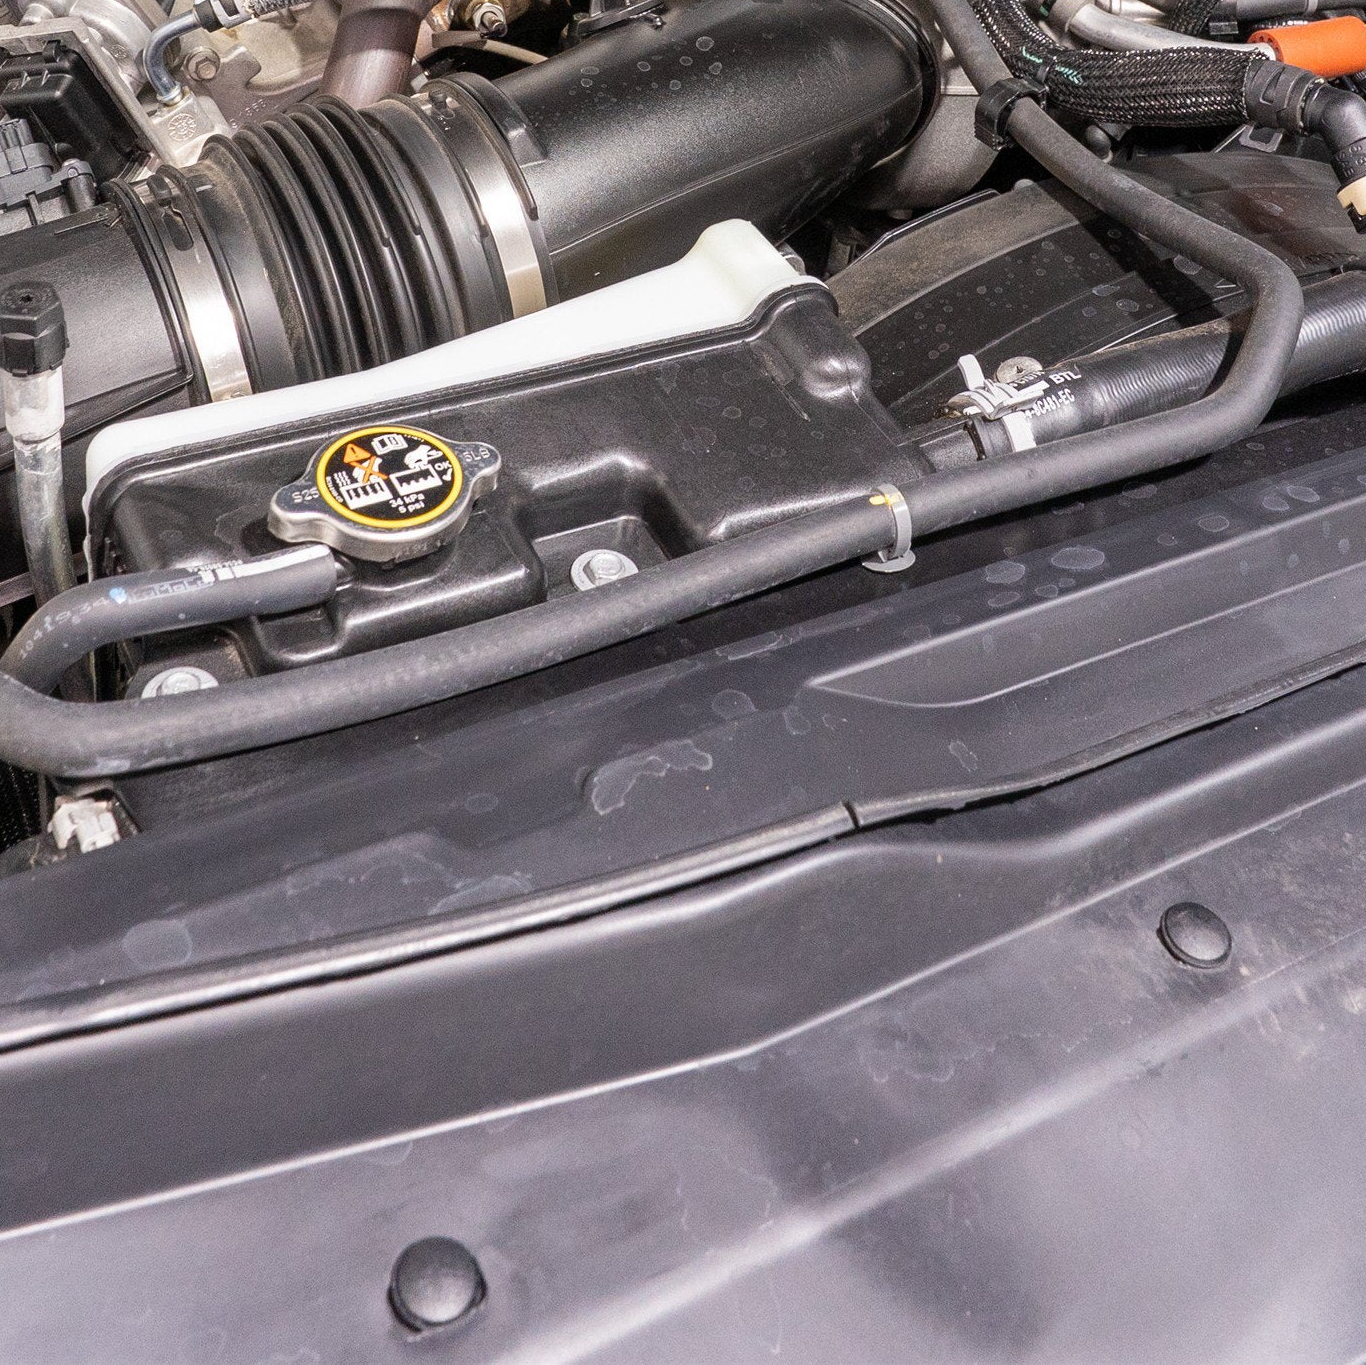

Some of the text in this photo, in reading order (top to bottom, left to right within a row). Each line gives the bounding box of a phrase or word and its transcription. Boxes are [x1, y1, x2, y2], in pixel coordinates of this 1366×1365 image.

[1049, 370, 1082, 384] BTL
[434, 460, 452, 471] OK
[389, 493, 425, 508] 34 kPa
[408, 502, 425, 512] psi
